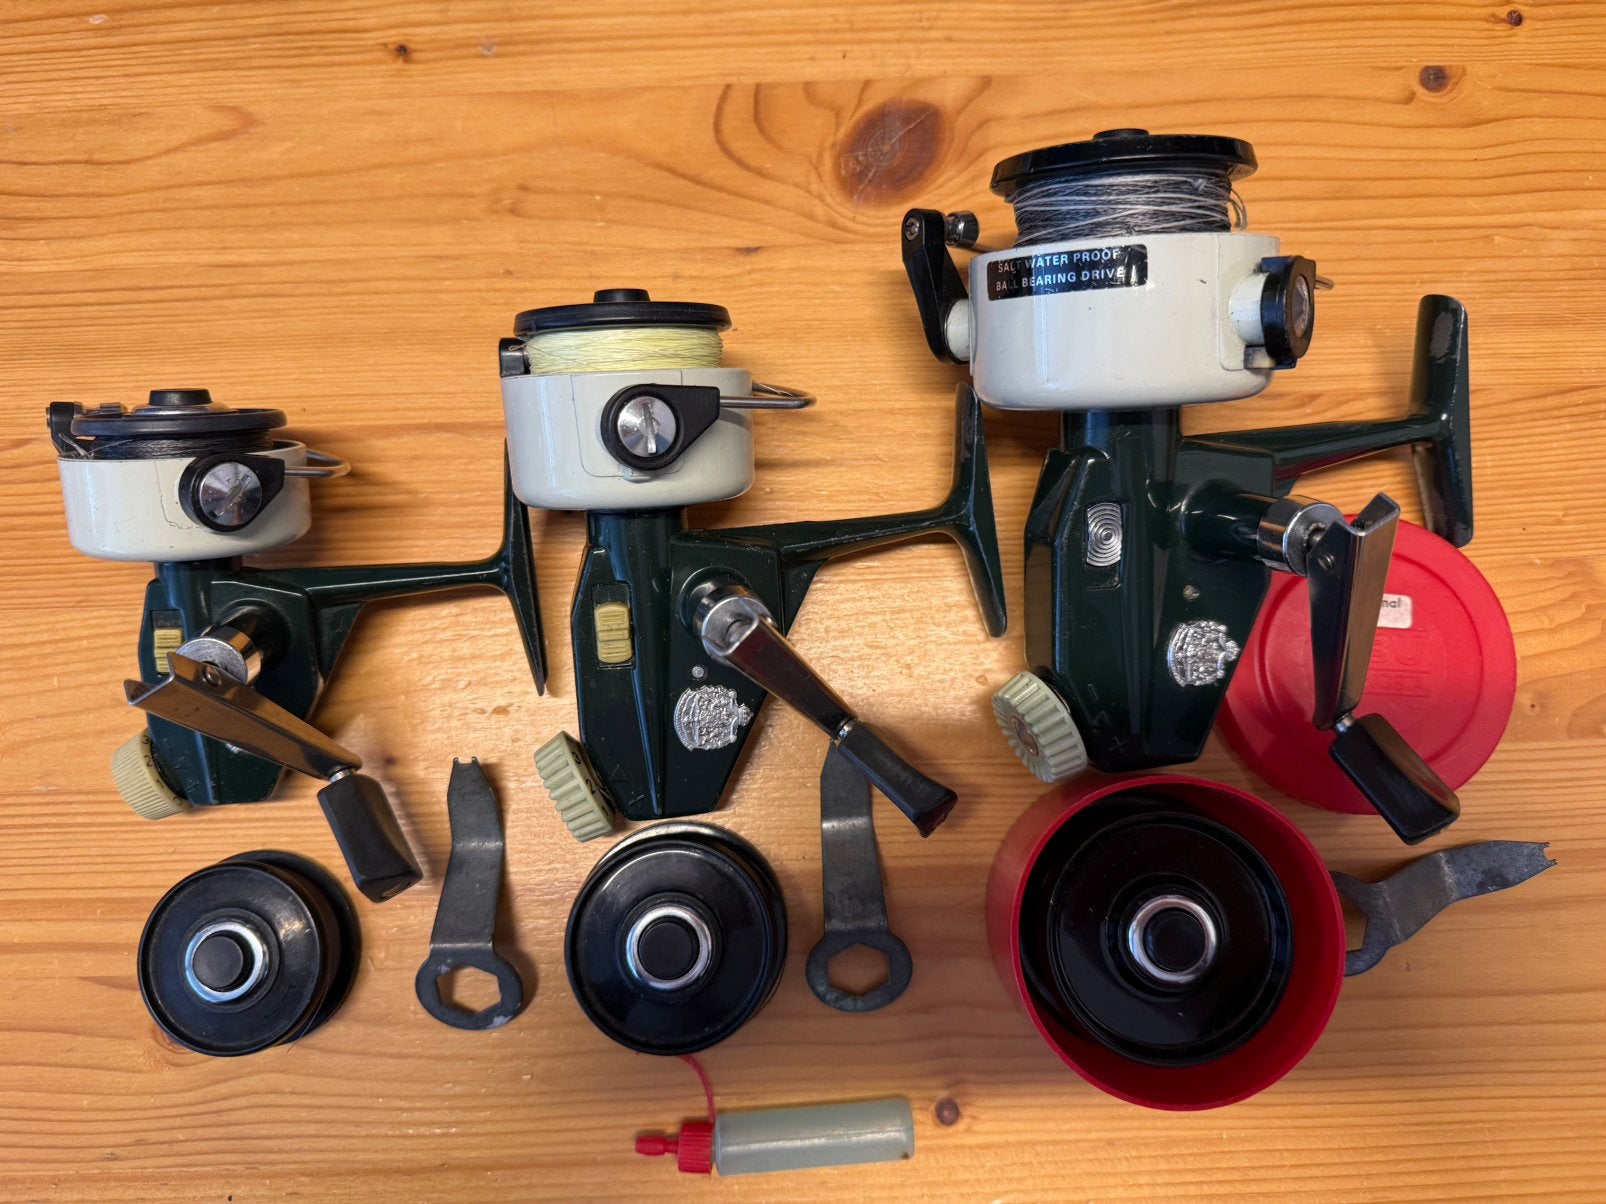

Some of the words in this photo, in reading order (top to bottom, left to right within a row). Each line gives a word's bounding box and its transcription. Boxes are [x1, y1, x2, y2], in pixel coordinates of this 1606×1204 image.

[998, 261, 1021, 273] SALT
[1025, 252, 1068, 269] WATER
[1073, 249, 1121, 262] PROOF
[996, 280, 1018, 291] BALL
[1022, 271, 1076, 287] BEARING
[1081, 266, 1125, 280] DRIVE
[144, 755, 152, 767] 2
